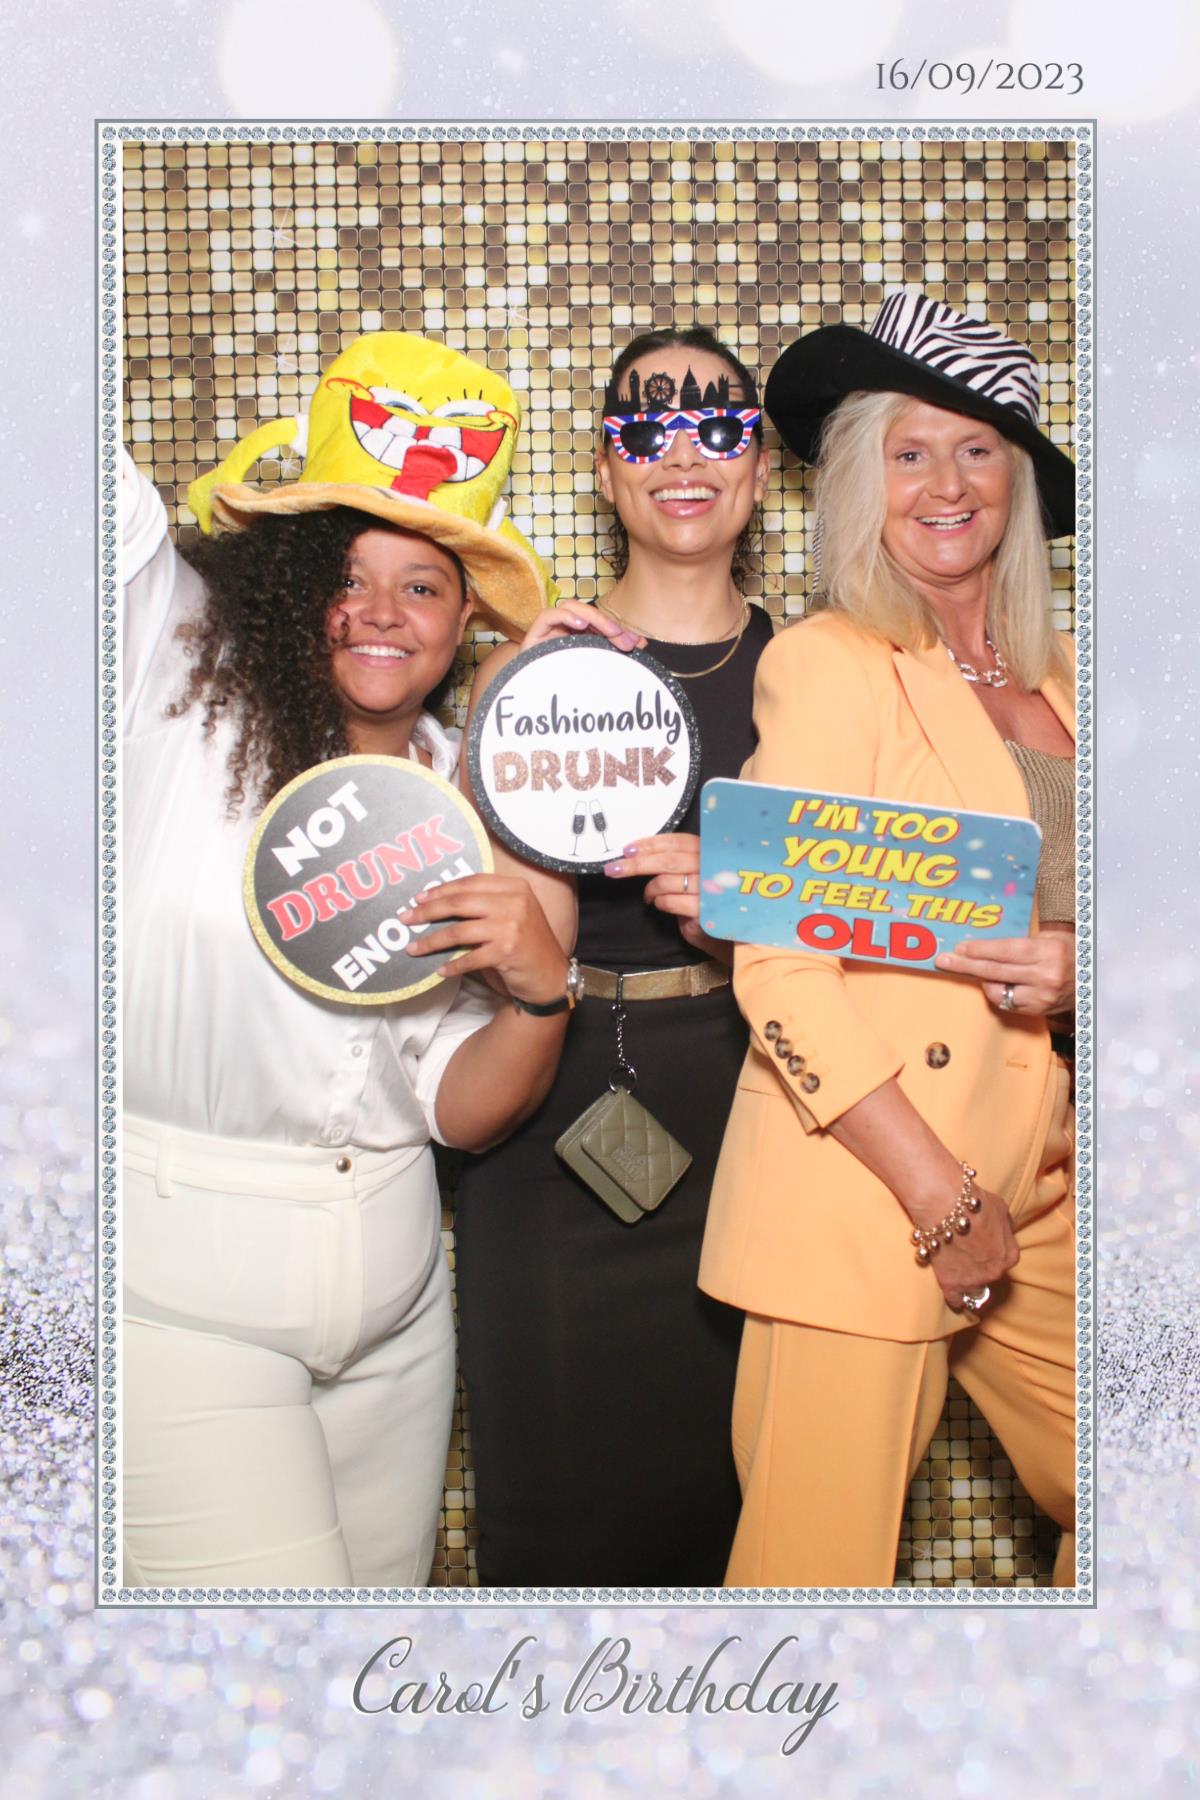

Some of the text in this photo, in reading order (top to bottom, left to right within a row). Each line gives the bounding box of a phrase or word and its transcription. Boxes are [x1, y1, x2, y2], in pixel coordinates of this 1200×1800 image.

[495, 690, 681, 745] Fashionably
[492, 746, 677, 793] DRUNK
[271, 780, 368, 877] NOT
[787, 799, 960, 844] I'M TOO
[267, 815, 464, 941] DRUNK
[783, 837, 960, 888] YOUNG
[331, 857, 476, 991] ENOH
[737, 870, 1003, 928] TO FEEL THIS
[797, 913, 938, 961] OLD
